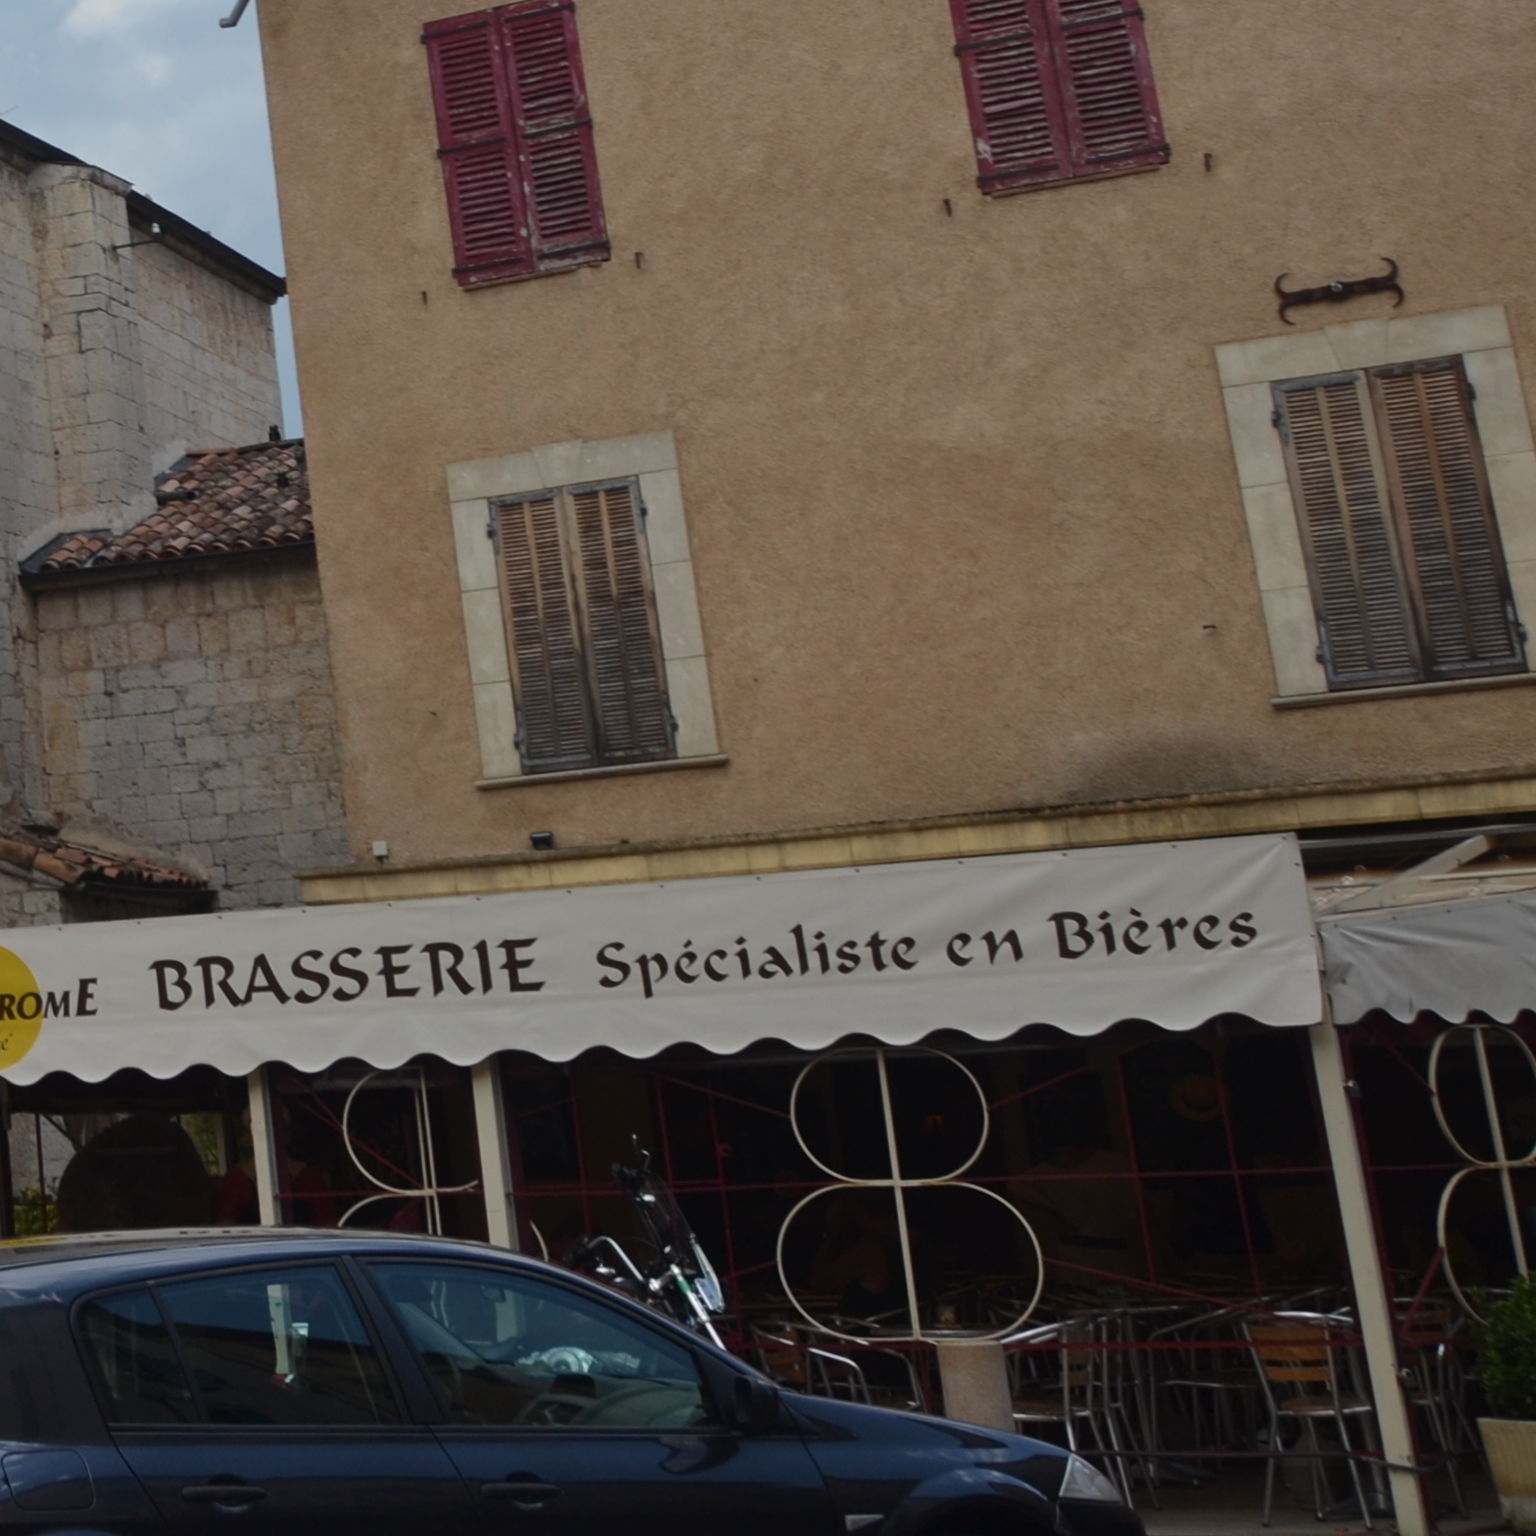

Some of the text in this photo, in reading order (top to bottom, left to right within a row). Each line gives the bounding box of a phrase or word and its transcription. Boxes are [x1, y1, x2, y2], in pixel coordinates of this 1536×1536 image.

[148, 907, 1258, 1012] BRASSERIE Spécialiste en Bières
